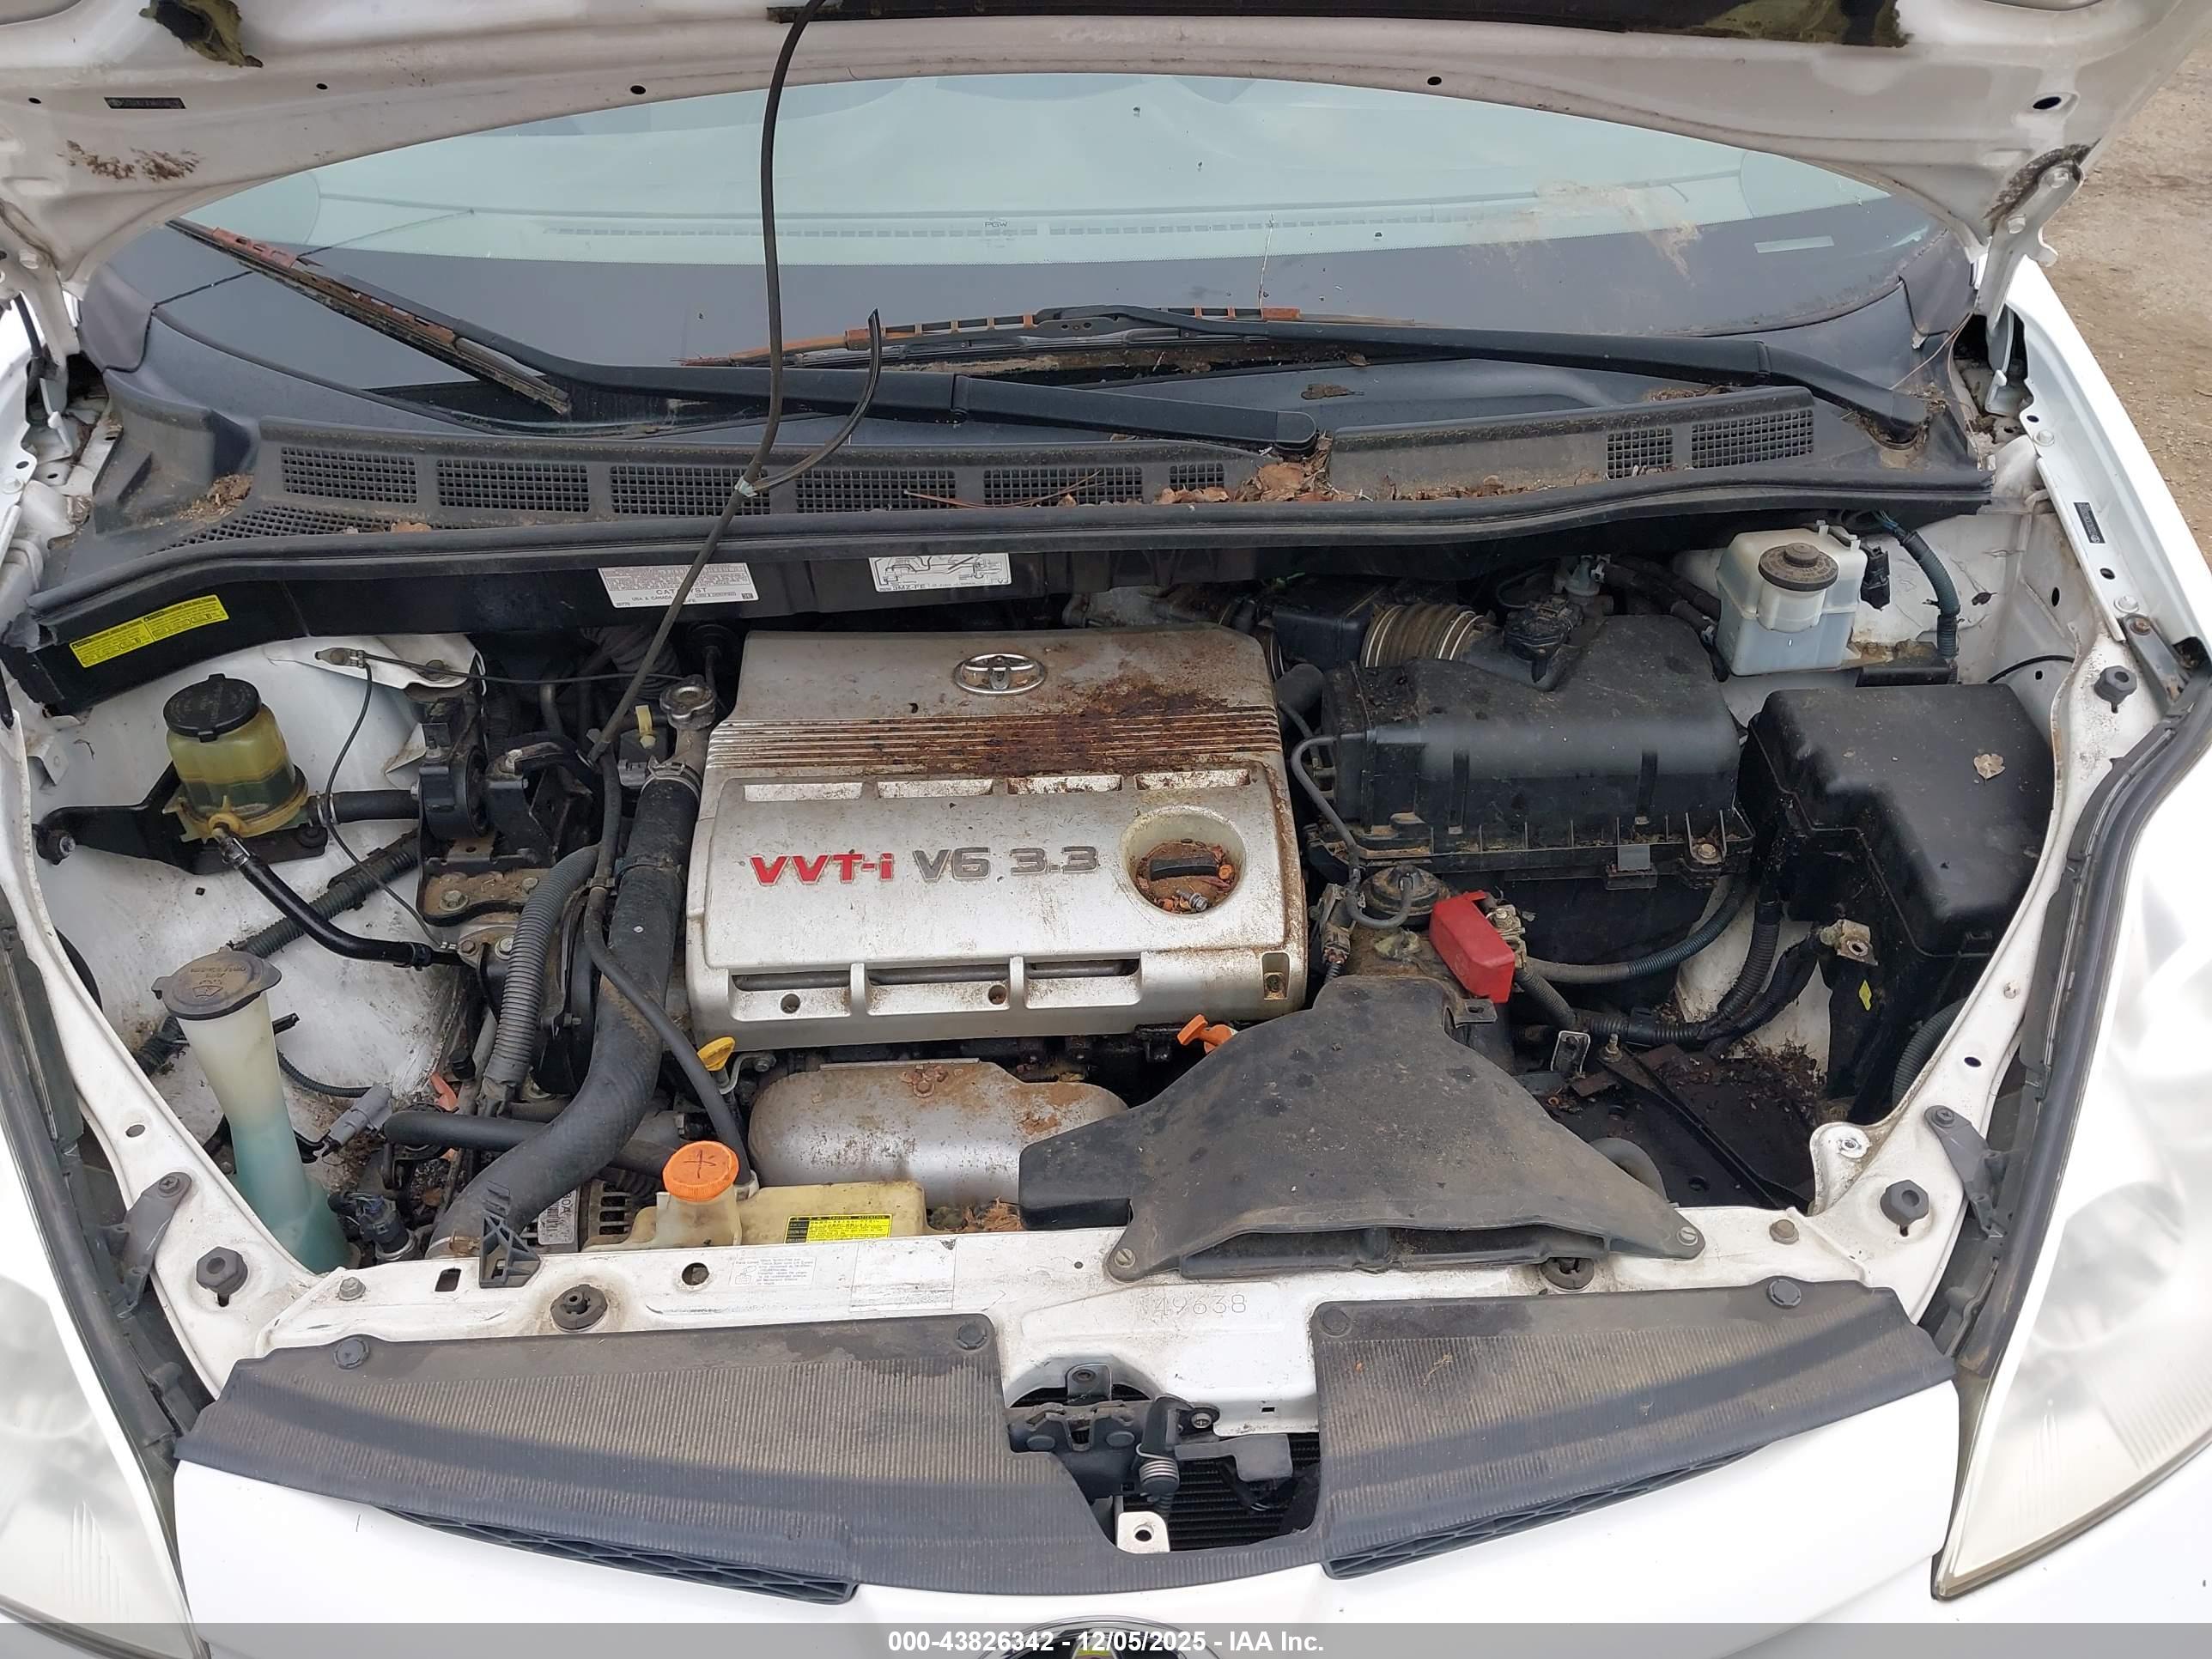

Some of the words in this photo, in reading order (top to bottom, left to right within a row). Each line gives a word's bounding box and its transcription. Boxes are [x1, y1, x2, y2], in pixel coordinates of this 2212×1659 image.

[750, 853, 894, 886] VVT-i
[913, 847, 992, 882] V6
[1010, 846, 1098, 874] 3.3
